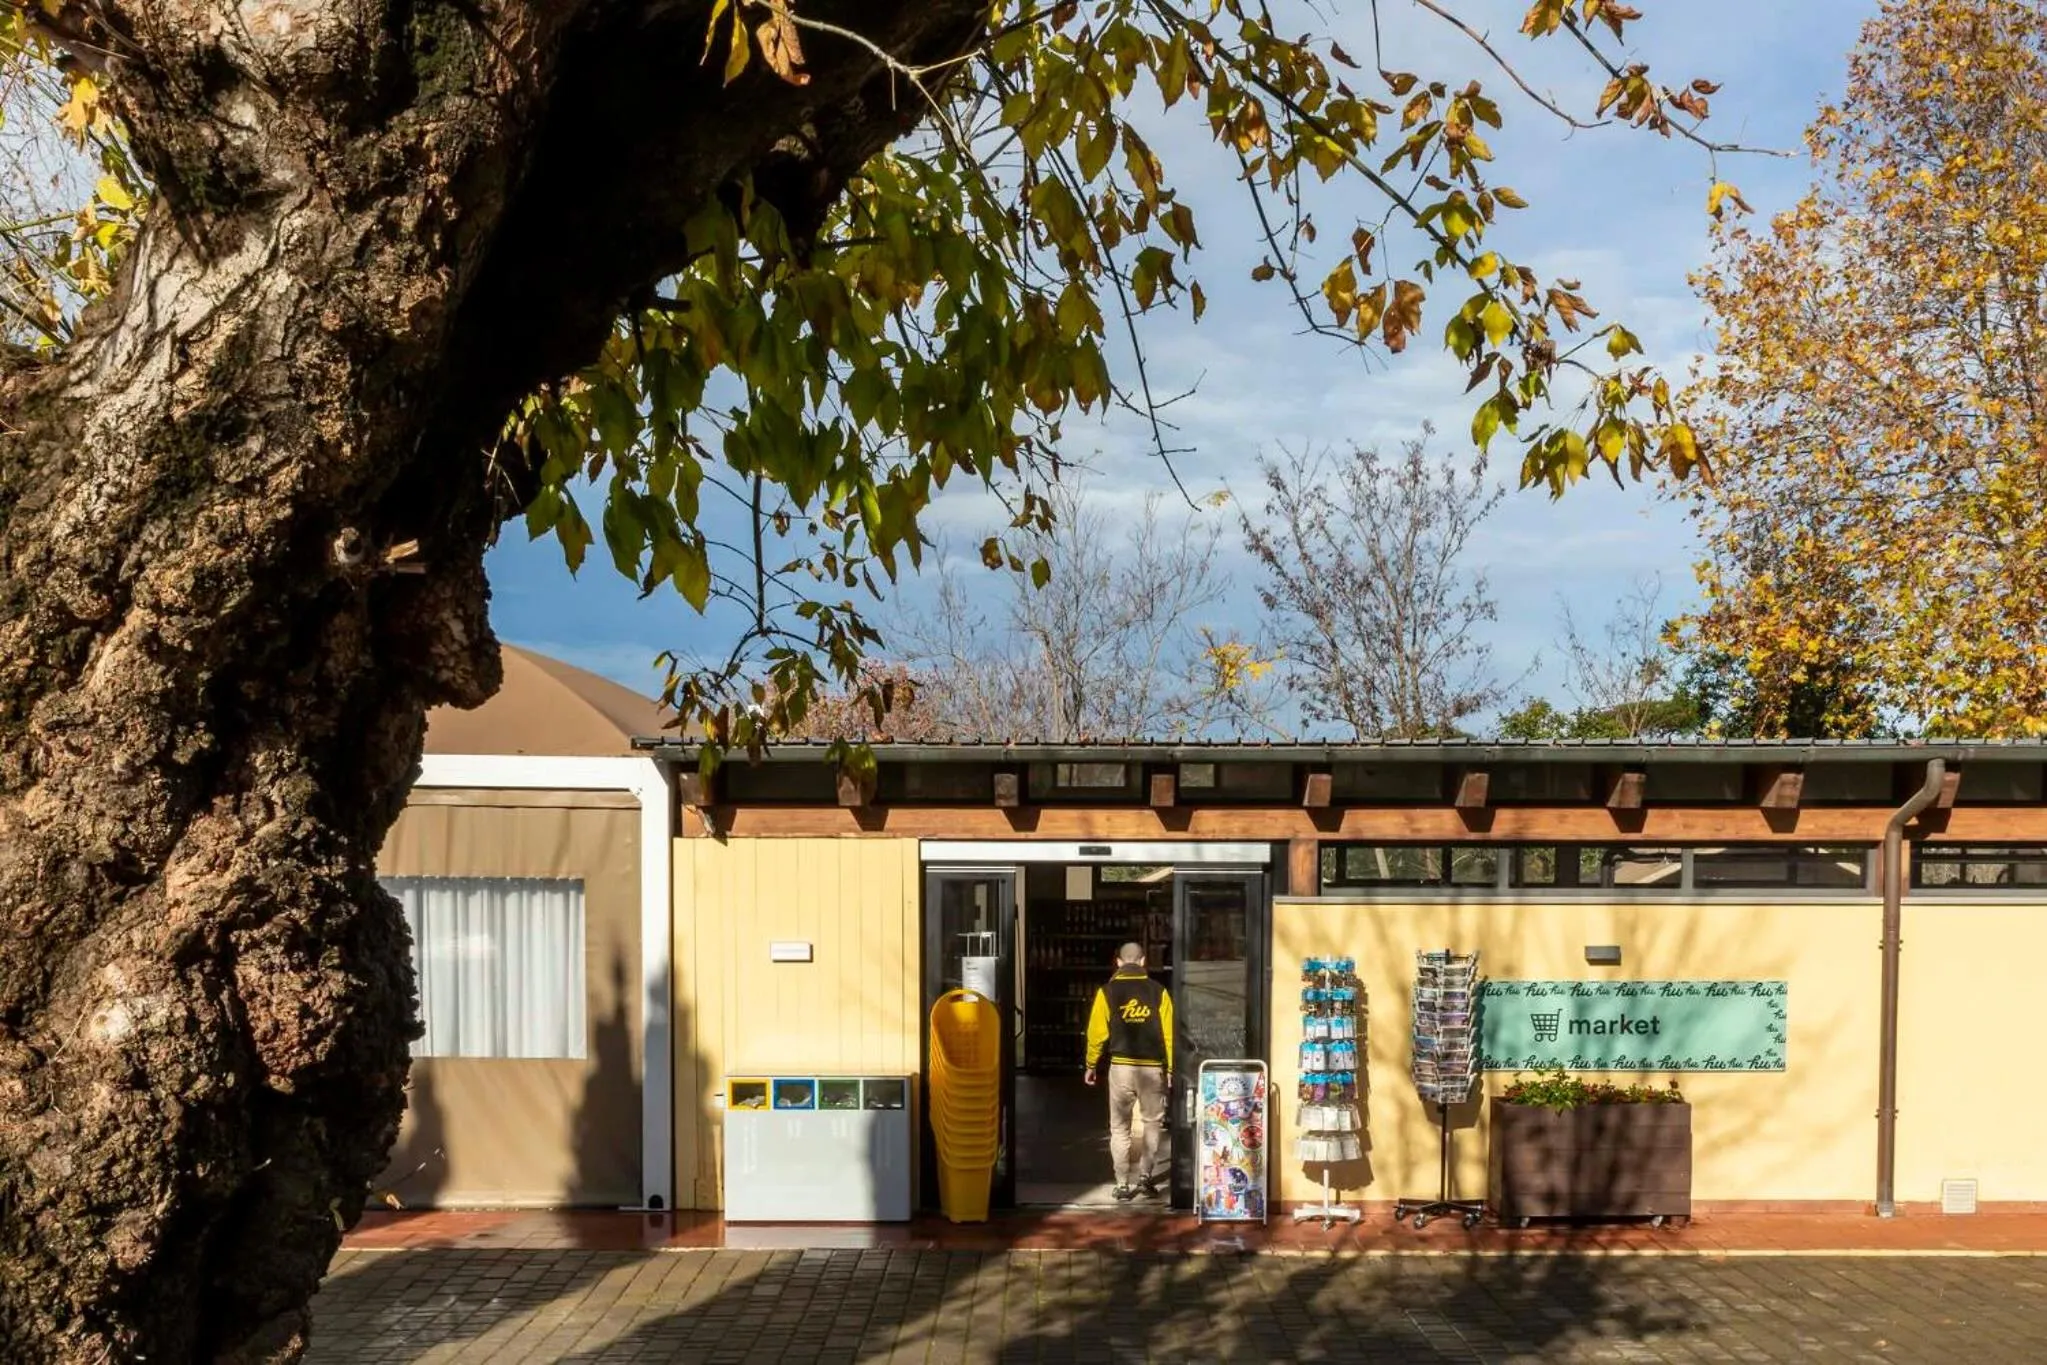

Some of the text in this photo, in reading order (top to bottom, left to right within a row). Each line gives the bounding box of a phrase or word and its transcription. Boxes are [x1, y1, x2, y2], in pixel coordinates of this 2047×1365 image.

[1523, 982, 1547, 997] hu
[1569, 982, 1592, 997] hu
[1614, 982, 1637, 997] hu
[1660, 982, 1683, 997] hu
[1704, 982, 1728, 997] hu
[1749, 982, 1773, 997] hu
[1568, 1013, 1660, 1035] market
[1522, 1054, 1546, 1069] hu
[1568, 1054, 1591, 1069] hu
[1612, 1054, 1636, 1069] hu
[1657, 1054, 1681, 1069] hu
[1702, 1054, 1726, 1069] hu
[1746, 1054, 1771, 1069] hu
